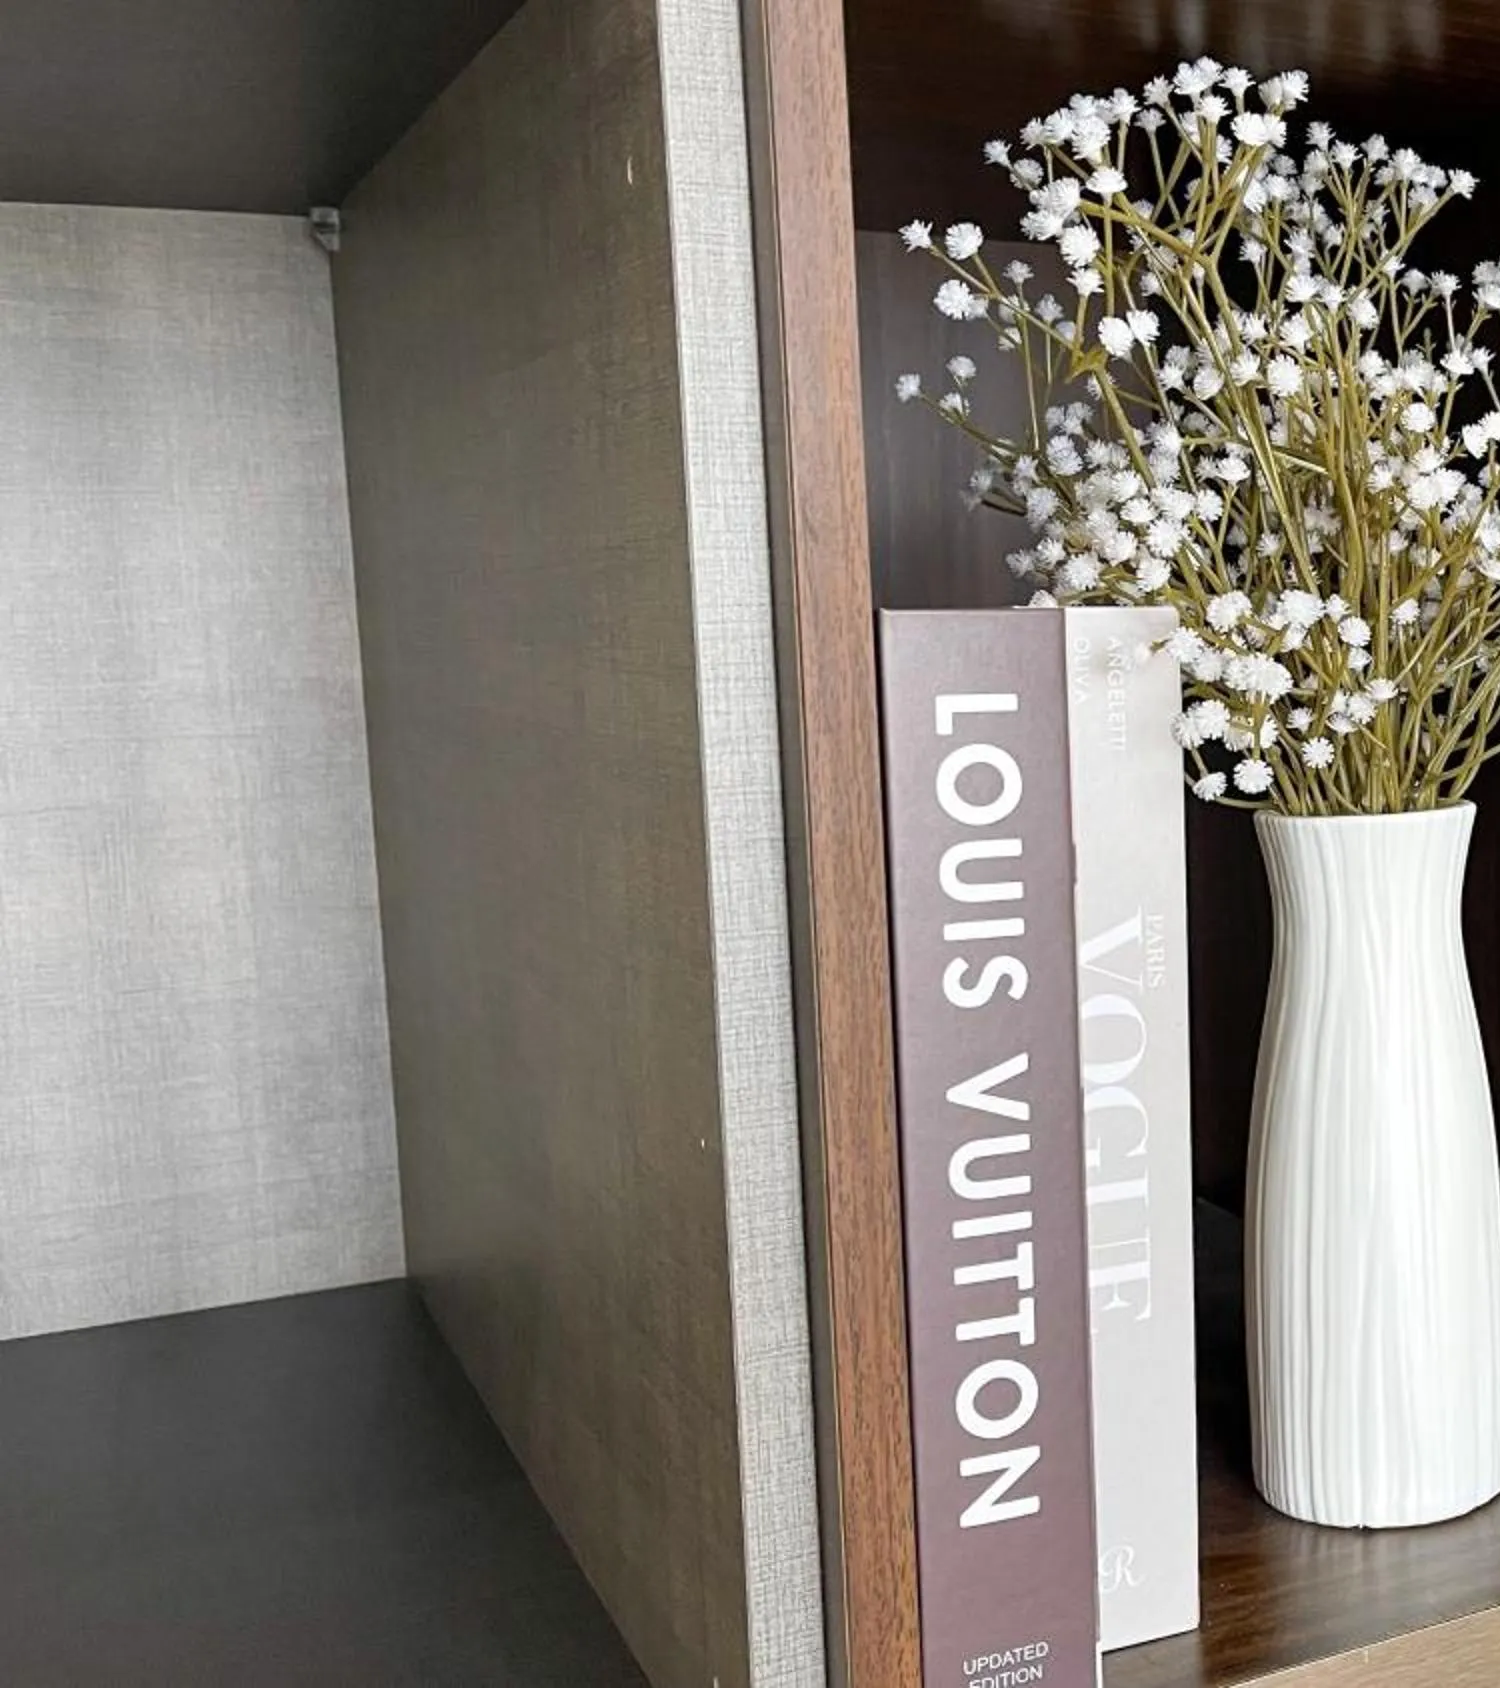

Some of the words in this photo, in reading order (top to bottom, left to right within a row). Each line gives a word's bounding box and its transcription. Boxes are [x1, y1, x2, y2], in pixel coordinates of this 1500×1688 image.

[1073, 637, 1091, 704] OLIVA
[935, 693, 1029, 1009] LOUIS
[1146, 914, 1165, 990] PARIS
[1079, 905, 1152, 1326] VOGUE
[945, 1052, 1041, 1529] VUITTON
[963, 1641, 1049, 1675] UPDATED
